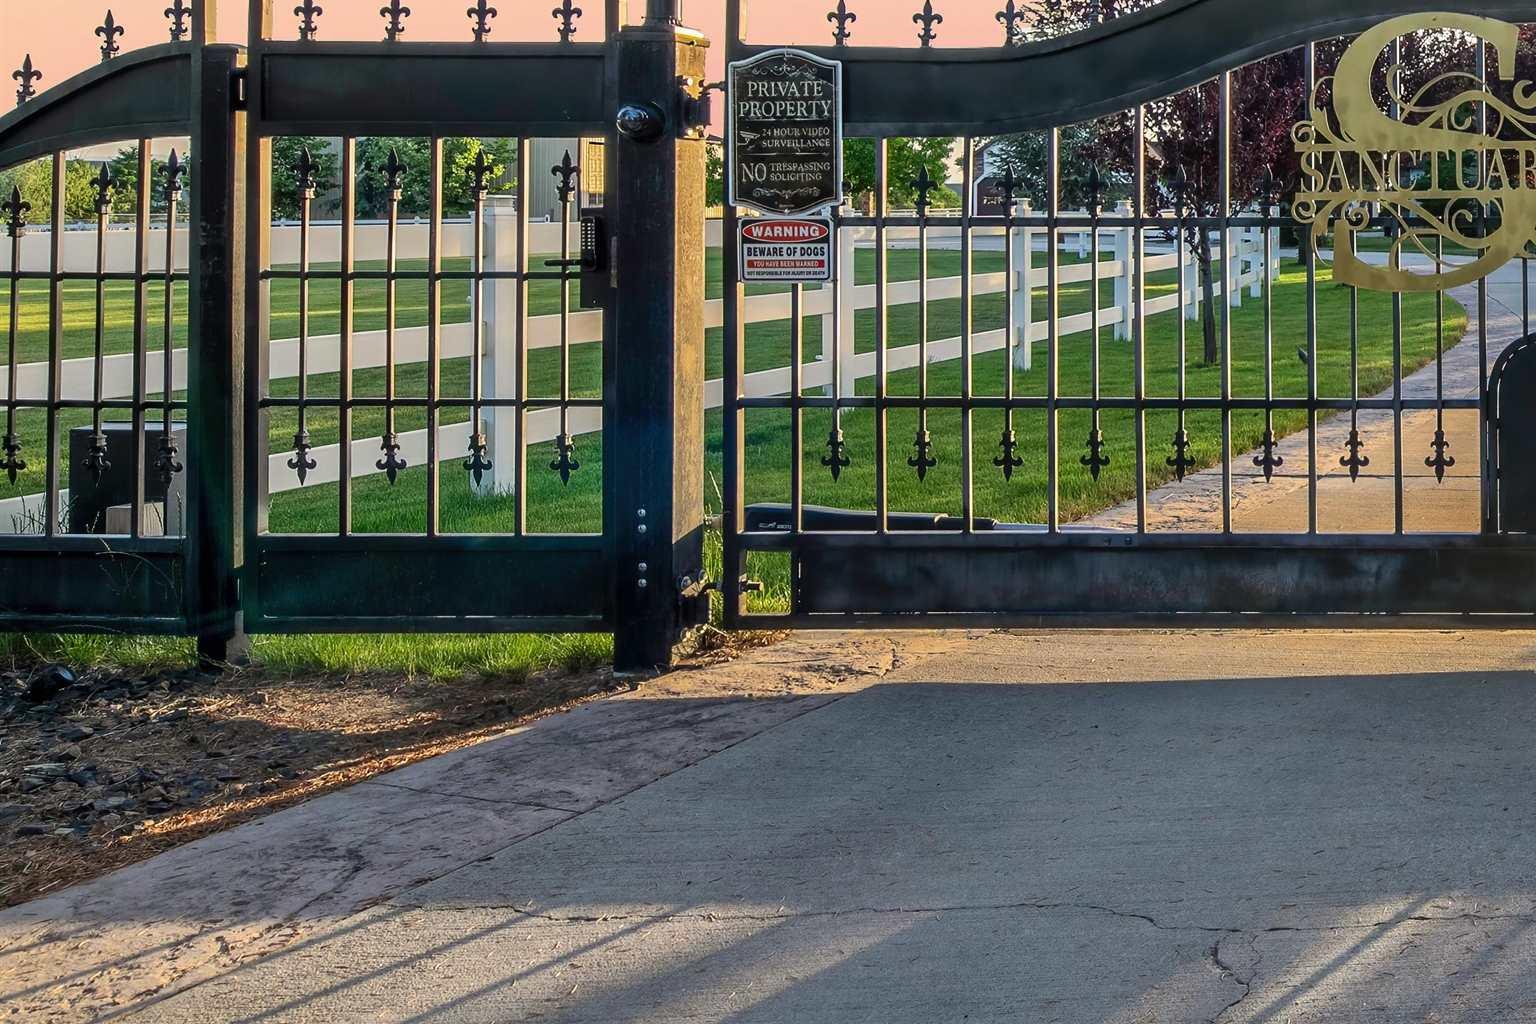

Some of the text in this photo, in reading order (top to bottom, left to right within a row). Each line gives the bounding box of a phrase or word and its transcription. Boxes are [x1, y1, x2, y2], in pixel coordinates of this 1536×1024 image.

[747, 81, 823, 97] PRIVATE
[739, 101, 831, 117] PROPERTY
[761, 127, 830, 136] 24 HOUR VIDEO
[761, 138, 830, 147] SURVEILLANCE
[769, 162, 831, 171] TRESPASSING
[741, 162, 767, 182] NO
[769, 172, 822, 182] SOLICITING
[751, 226, 820, 237] WARNING
[746, 246, 825, 257] BEWARE OF DOGS
[795, 260, 819, 268] WARNED
